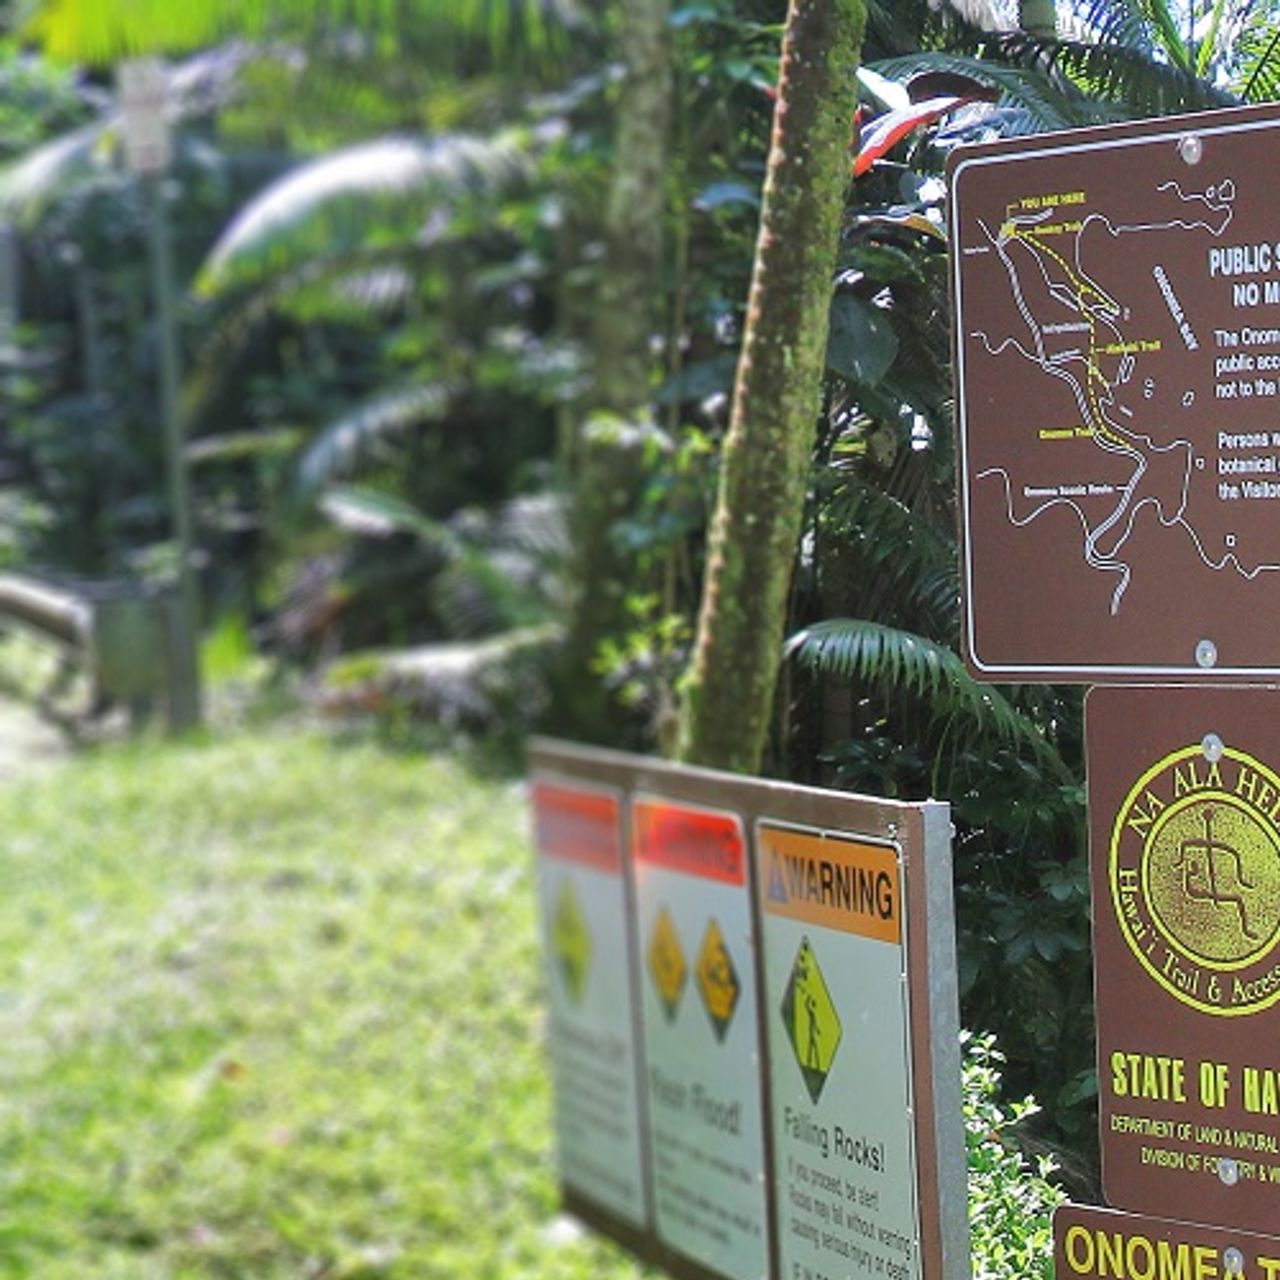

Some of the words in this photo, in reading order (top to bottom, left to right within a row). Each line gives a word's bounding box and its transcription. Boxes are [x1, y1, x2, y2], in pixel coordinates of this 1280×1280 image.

[1209, 243, 1271, 277] PUBLIC
[1234, 283, 1259, 306] NO
[1215, 330, 1238, 347] The
[1216, 355, 1254, 376] public
[1216, 381, 1237, 398] not
[1239, 380, 1252, 396] to
[1255, 378, 1276, 395] the
[1218, 431, 1269, 448] Persons
[1218, 456, 1275, 474] botanical
[1218, 482, 1238, 499] the
[1127, 791, 1165, 838] NA
[1173, 763, 1223, 798] ALA
[784, 853, 893, 920] WARNING
[1161, 950, 1200, 994] Trail
[1208, 975, 1221, 1001] &
[1111, 1052, 1187, 1103] STATE
[1200, 1061, 1229, 1107] OF
[784, 1106, 829, 1159] Falling
[834, 1126, 885, 1173] Rocks!
[1110, 1113, 1174, 1139] DEPARTMENT
[1177, 1123, 1192, 1141] OF
[1196, 1126, 1222, 1145] LAND
[1224, 1130, 1231, 1147] &
[1234, 1132, 1279, 1154] NATURAL
[1141, 1147, 1184, 1169] DIVISION
[1187, 1155, 1201, 1171] OF
[1203, 1157, 1256, 1179] FOTRY
[1259, 1165, 1267, 1181] &
